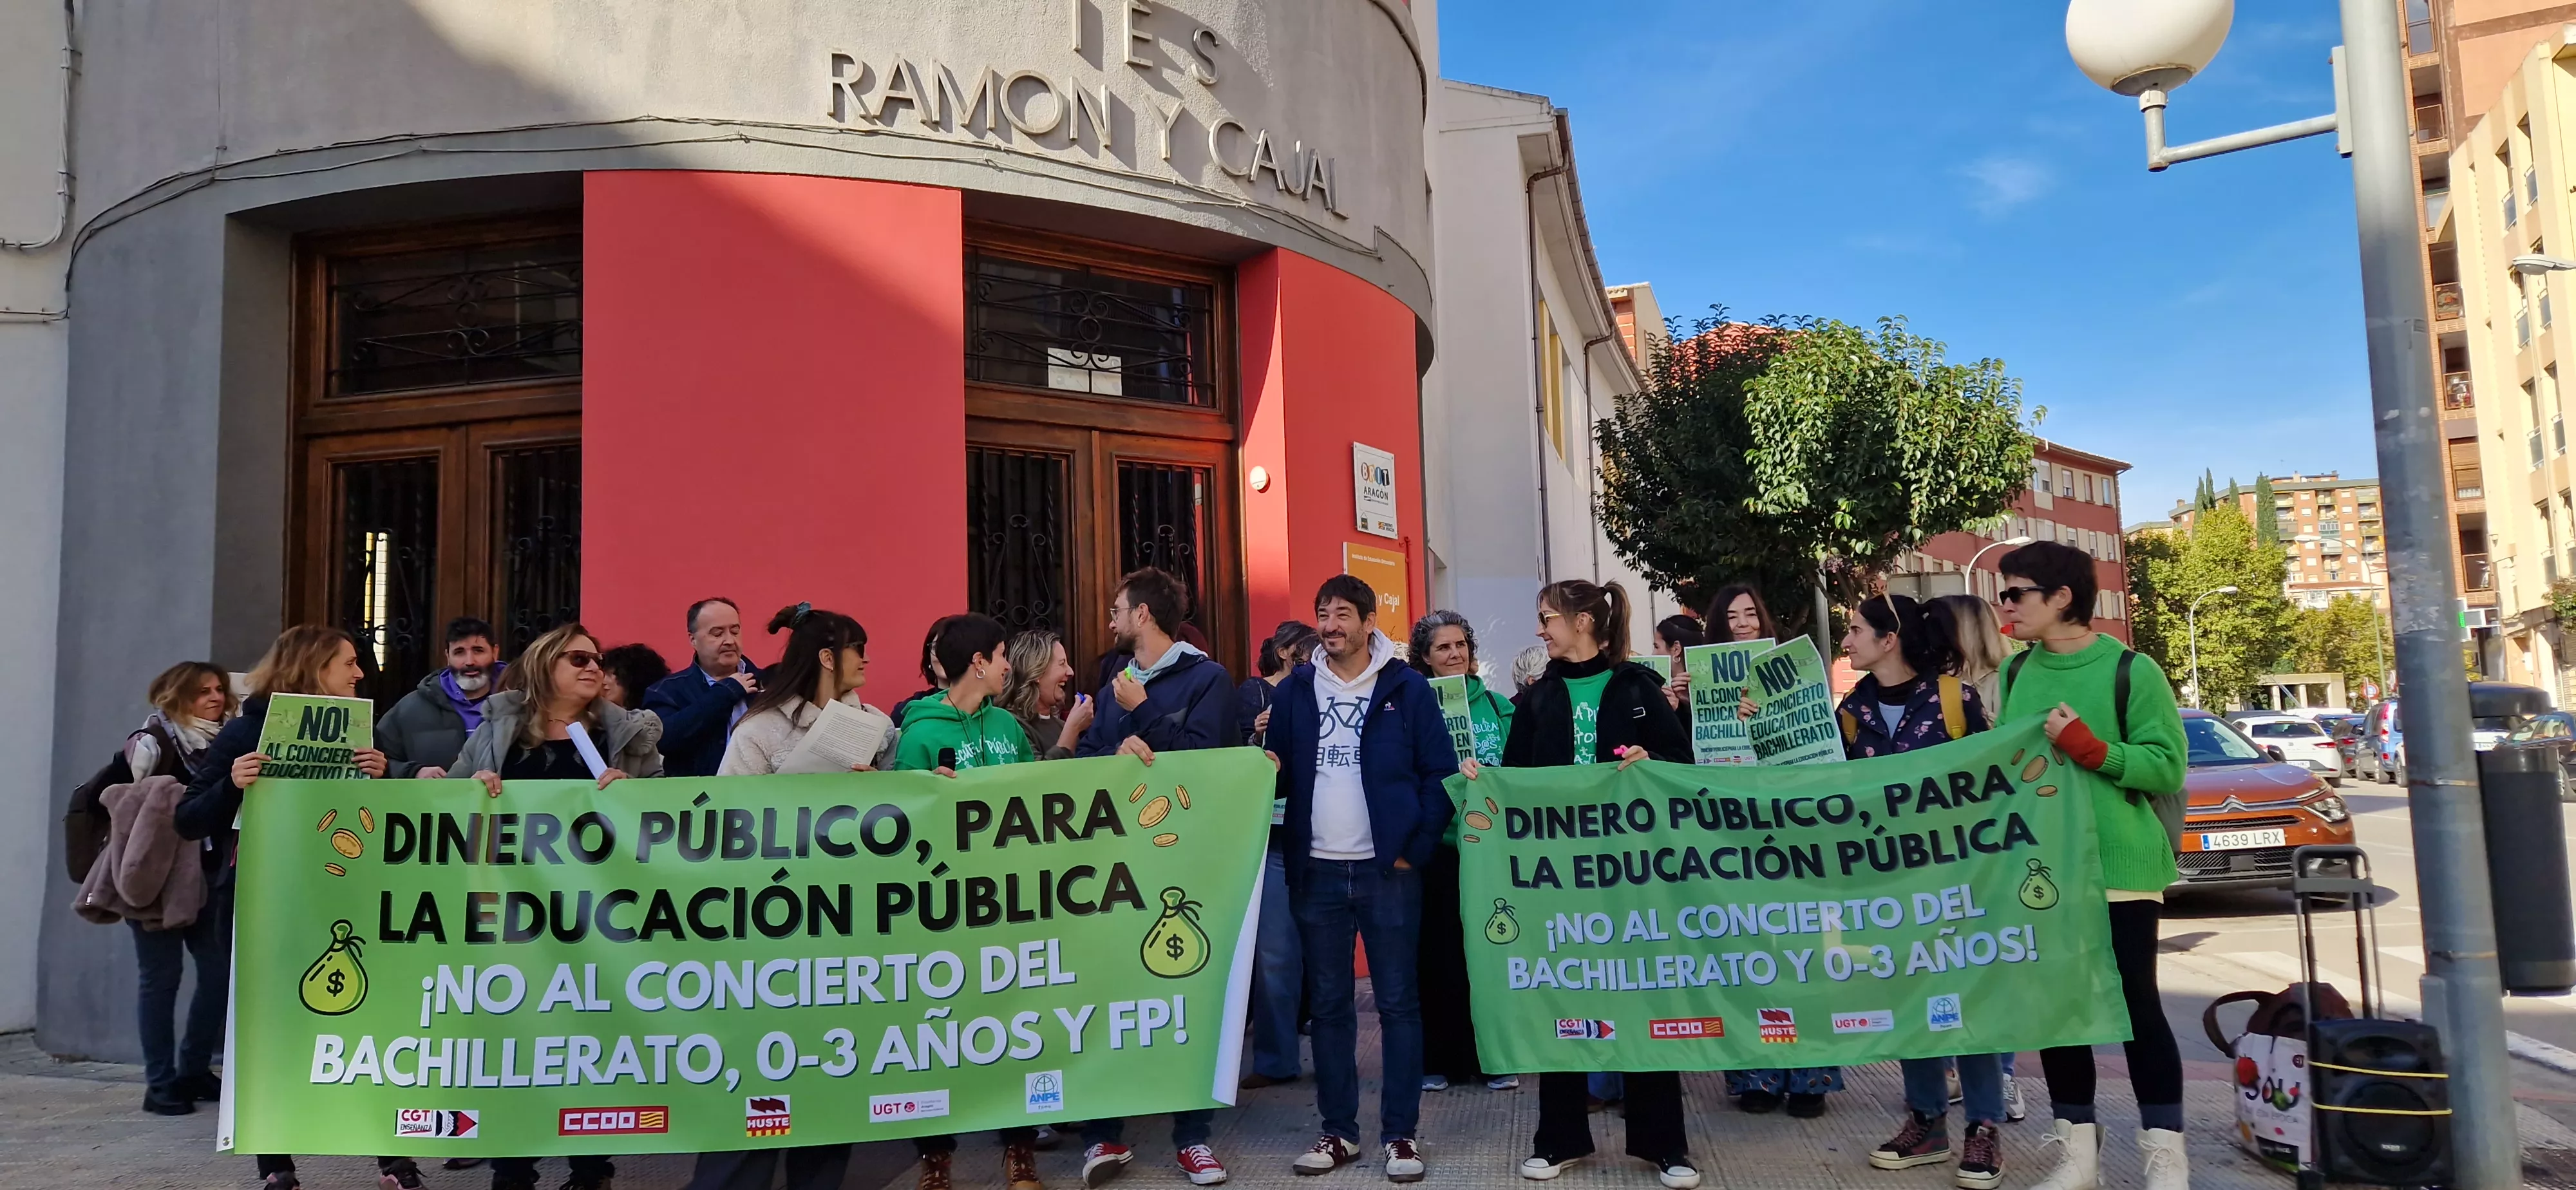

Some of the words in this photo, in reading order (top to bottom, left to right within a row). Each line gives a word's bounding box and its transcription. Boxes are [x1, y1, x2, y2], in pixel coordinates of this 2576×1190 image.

[826, 48, 1112, 148] RAMON
[1141, 93, 1184, 160] Y
[1208, 117, 1349, 220] CAJAL
[1361, 462, 1389, 486] BRIT
[1363, 486, 1388, 501] ARAGÓN
[1378, 594, 1383, 606] y
[1384, 592, 1400, 612] Cajal
[1755, 653, 1802, 697] NO!
[1696, 689, 1711, 705] AL
[1766, 683, 1824, 719] CONCIERTO
[296, 705, 350, 743] NO!
[1750, 707, 1810, 741] EDUCATIVO
[1813, 701, 1830, 722] EN
[1455, 732, 1471, 748] EN
[1752, 721, 1835, 761] BACHILLERATO
[265, 742, 281, 760] AL
[285, 744, 355, 764] CONCIER
[1504, 798, 1656, 840] DINERO
[1669, 787, 1872, 831] PÚBLICO,
[1883, 764, 2016, 818] PARA
[383, 811, 616, 865] DINERO
[636, 791, 933, 865] PÚBLICO,
[955, 788, 1128, 851] PARA
[1510, 855, 1564, 890] LA
[1573, 833, 1826, 889] EDUCACIÓN
[1837, 811, 2040, 876] PÚBLICA
[2213, 833, 2248, 848] 4639
[2254, 832, 2280, 845] LRX
[378, 890, 449, 944] LA
[464, 867, 853, 945] EDUCACIÓN
[876, 861, 1148, 936] PÚBLICA
[1546, 912, 1615, 952] ¡NO
[1622, 909, 1671, 943] AL
[1677, 896, 1904, 939] CONCIERTO
[1911, 883, 1986, 925] DEL
[1508, 951, 1779, 992] BACHILLERATO
[1783, 949, 1814, 983] Y
[1823, 945, 1897, 981] 0-3
[1905, 923, 2040, 977] AÑOS!
[420, 963, 527, 1028] ¡NO
[537, 963, 612, 1014] AL
[625, 950, 967, 1012] CONCIERTO
[980, 938, 1077, 995] DEL
[1559, 1019, 1581, 1028] CGT
[1653, 1022, 1703, 1035] CCOO
[1835, 1019, 1857, 1028] UGT
[1931, 1013, 1959, 1023] ANPE
[1761, 1026, 1796, 1036] HUSTE
[309, 1033, 741, 1093] BACHILLERATO,
[756, 1028, 860, 1082] 0-3
[869, 1006, 1044, 1075] AÑOS
[1052, 1003, 1096, 1055] Y
[1108, 994, 1190, 1050] FP!
[1030, 1091, 1060, 1103] ANPE
[401, 1109, 431, 1122] CGT
[873, 1102, 902, 1115] UGT
[564, 1112, 636, 1131] CCOO
[747, 1117, 790, 1129] HUSTE
